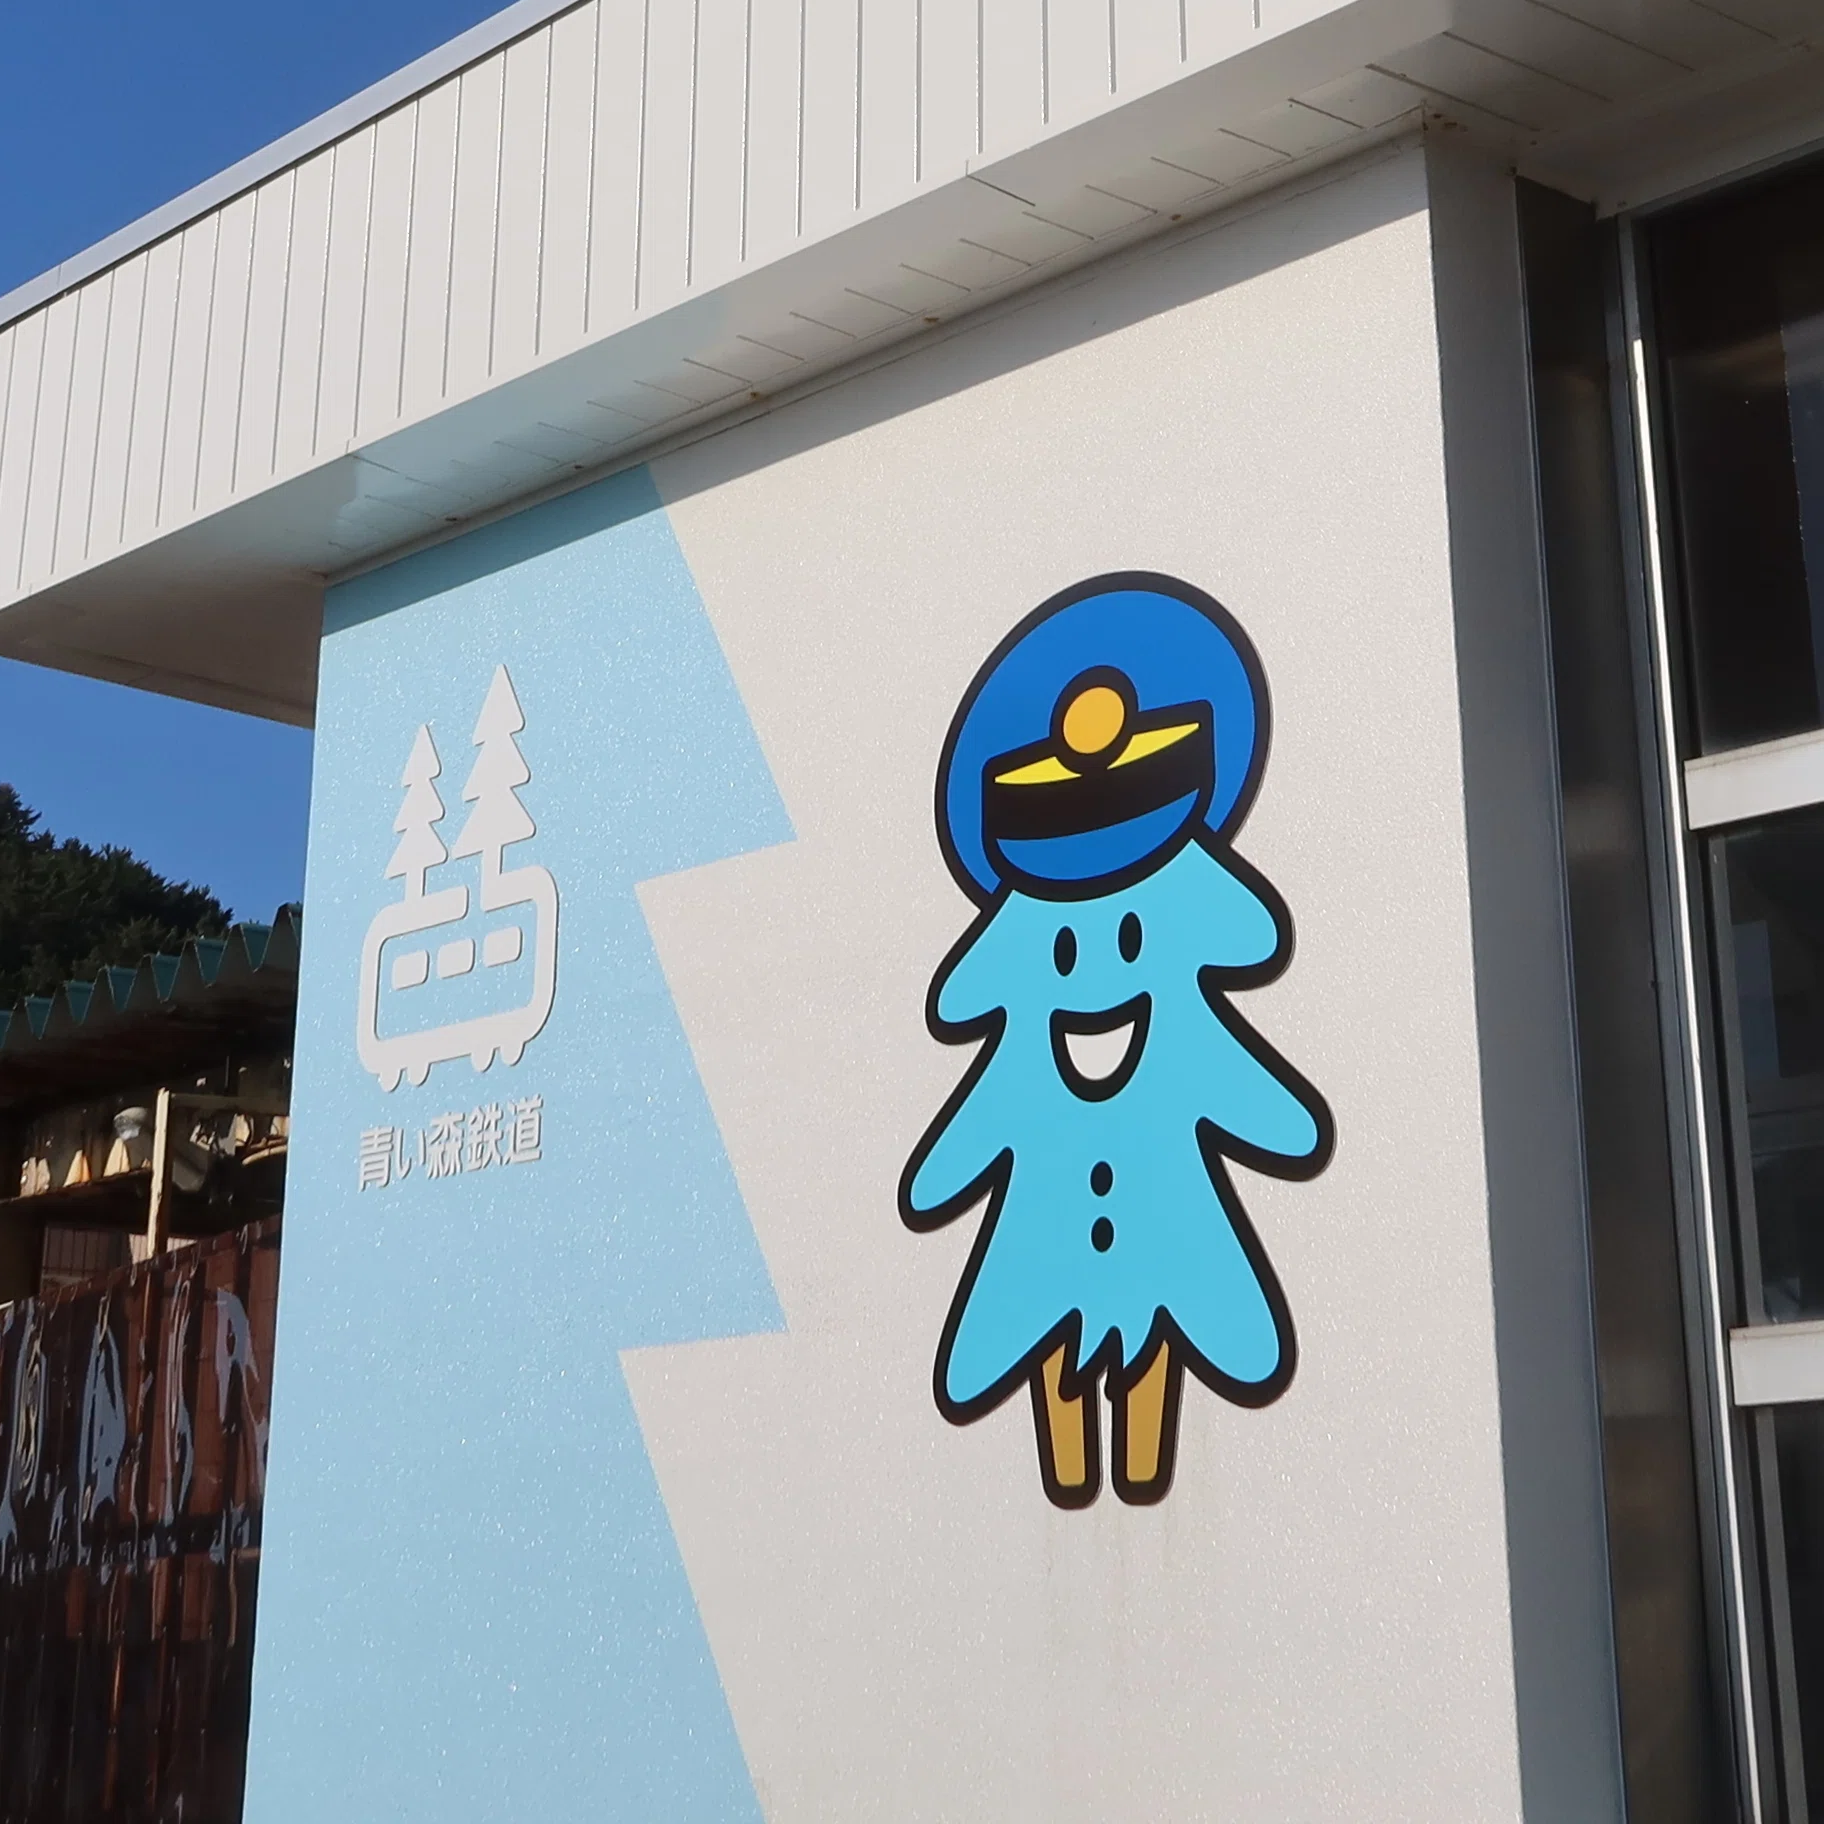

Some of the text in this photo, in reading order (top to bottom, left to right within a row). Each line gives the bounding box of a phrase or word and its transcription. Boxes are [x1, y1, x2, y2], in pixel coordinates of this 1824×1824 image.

[358, 1094, 543, 1192] 青い森鉄道
